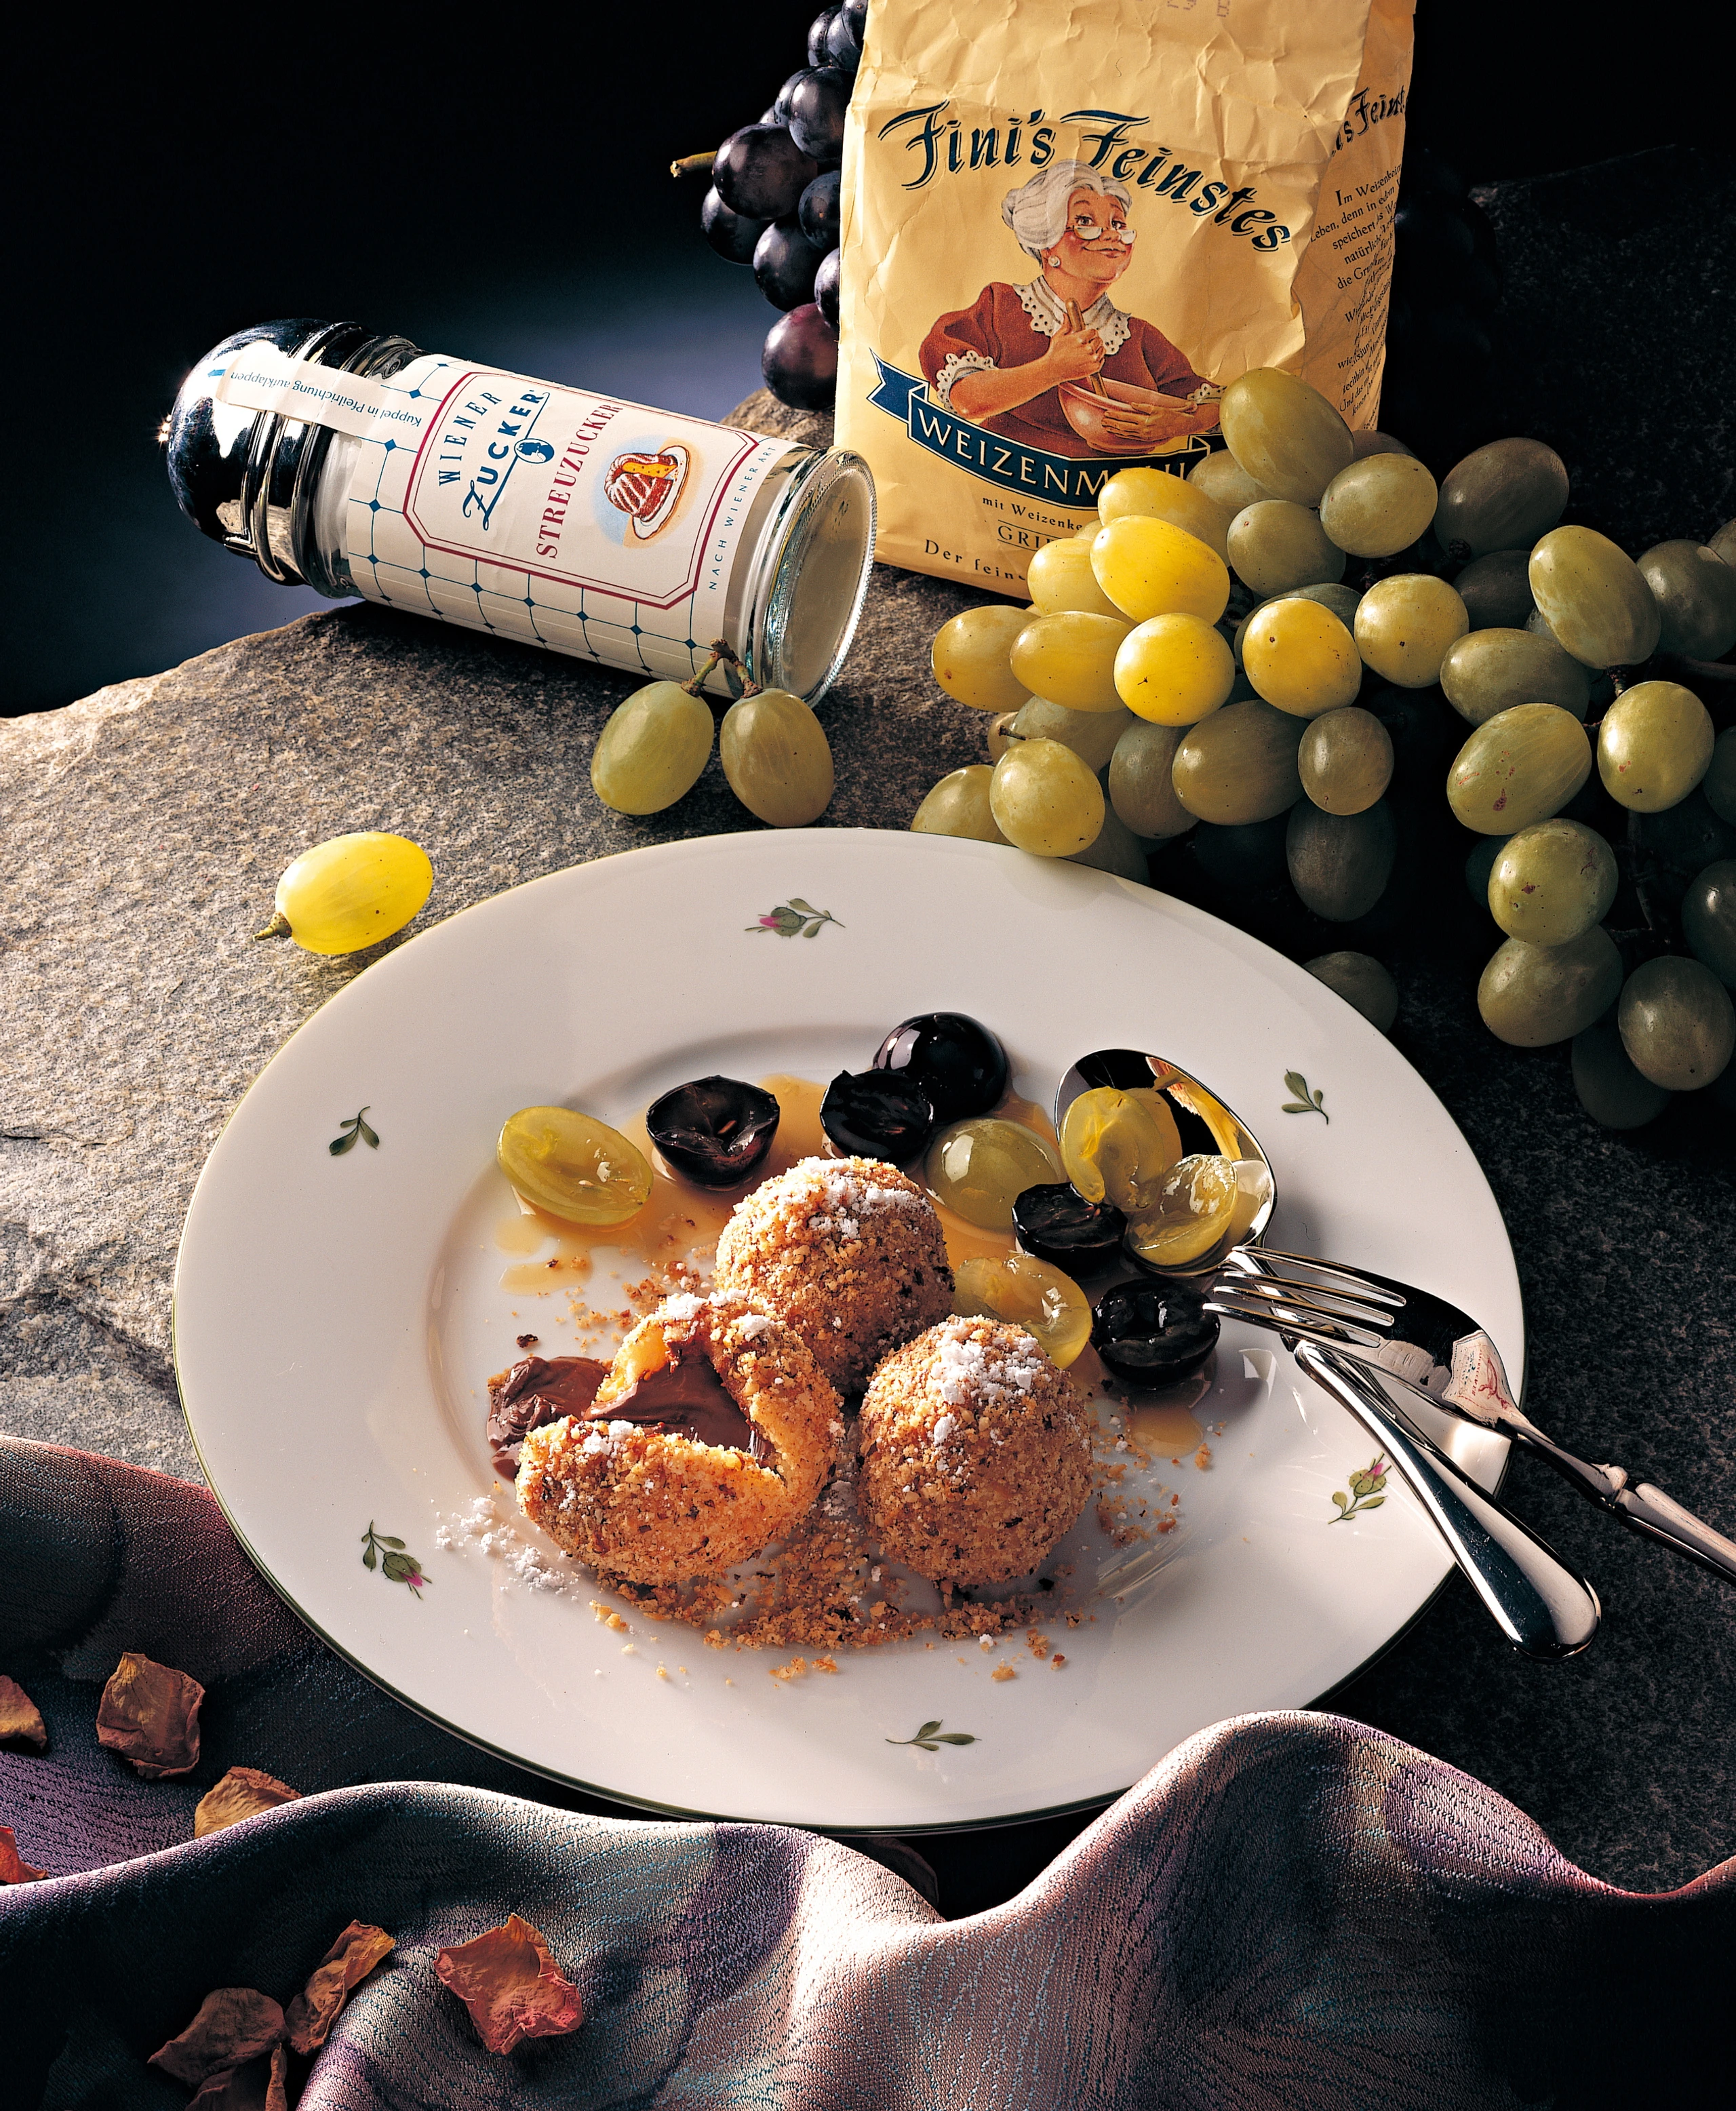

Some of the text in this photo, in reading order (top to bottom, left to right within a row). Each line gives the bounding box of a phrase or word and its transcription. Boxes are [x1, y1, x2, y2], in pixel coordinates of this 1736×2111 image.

[880, 100, 1290, 252] Fini's Feinstes
[1335, 189, 1353, 207] Im
[1332, 221, 1376, 250] speichert
[1341, 211, 1364, 224] denn
[1366, 201, 1377, 212] in
[1337, 277, 1353, 290] die
[231, 372, 422, 427] Kuppel in Pfeilrichtung aufklappen
[438, 391, 502, 486] WIENER
[462, 389, 550, 531] ZUCKER
[918, 408, 1185, 496] WEIZENM
[536, 403, 623, 559] STREUZUCKER
[982, 495, 1004, 510] mit
[709, 447, 776, 590] NACH WIENER ART
[924, 538, 963, 564] Der
